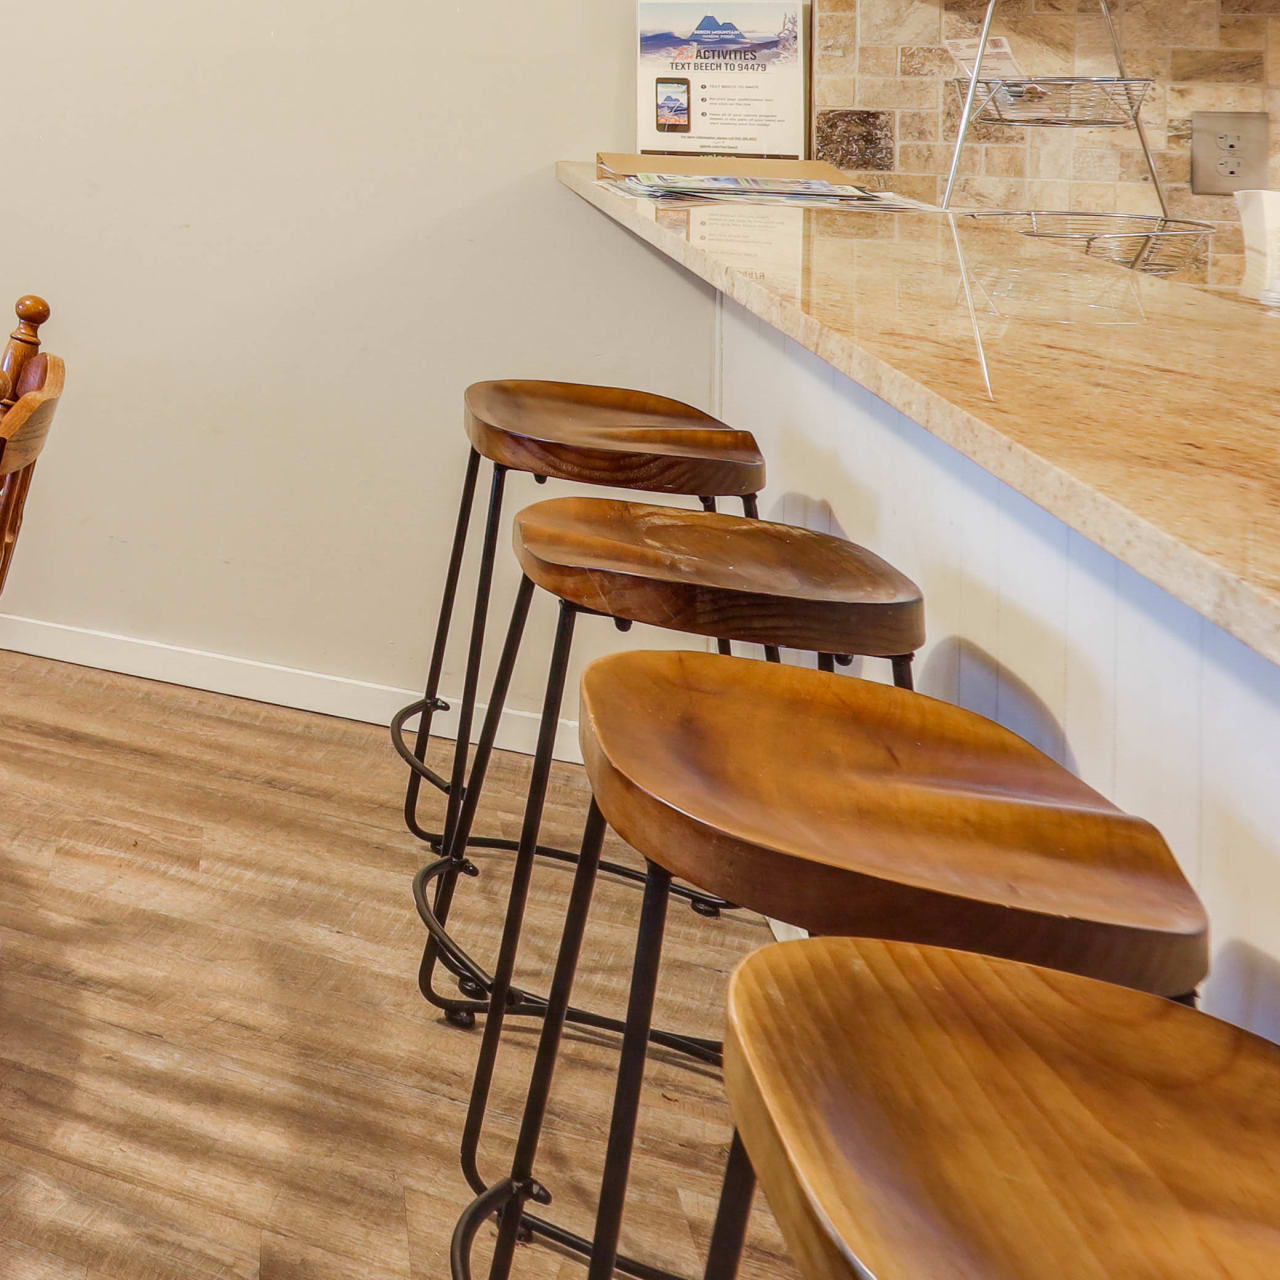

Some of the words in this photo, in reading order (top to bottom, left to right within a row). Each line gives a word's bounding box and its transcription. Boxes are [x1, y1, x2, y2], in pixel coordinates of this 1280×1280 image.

[695, 49, 757, 61] ACTIVITIES
[670, 62, 691, 71] TEXT
[693, 62, 722, 71] BEECH
[725, 62, 736, 72] TO
[737, 63, 767, 72] 94479
